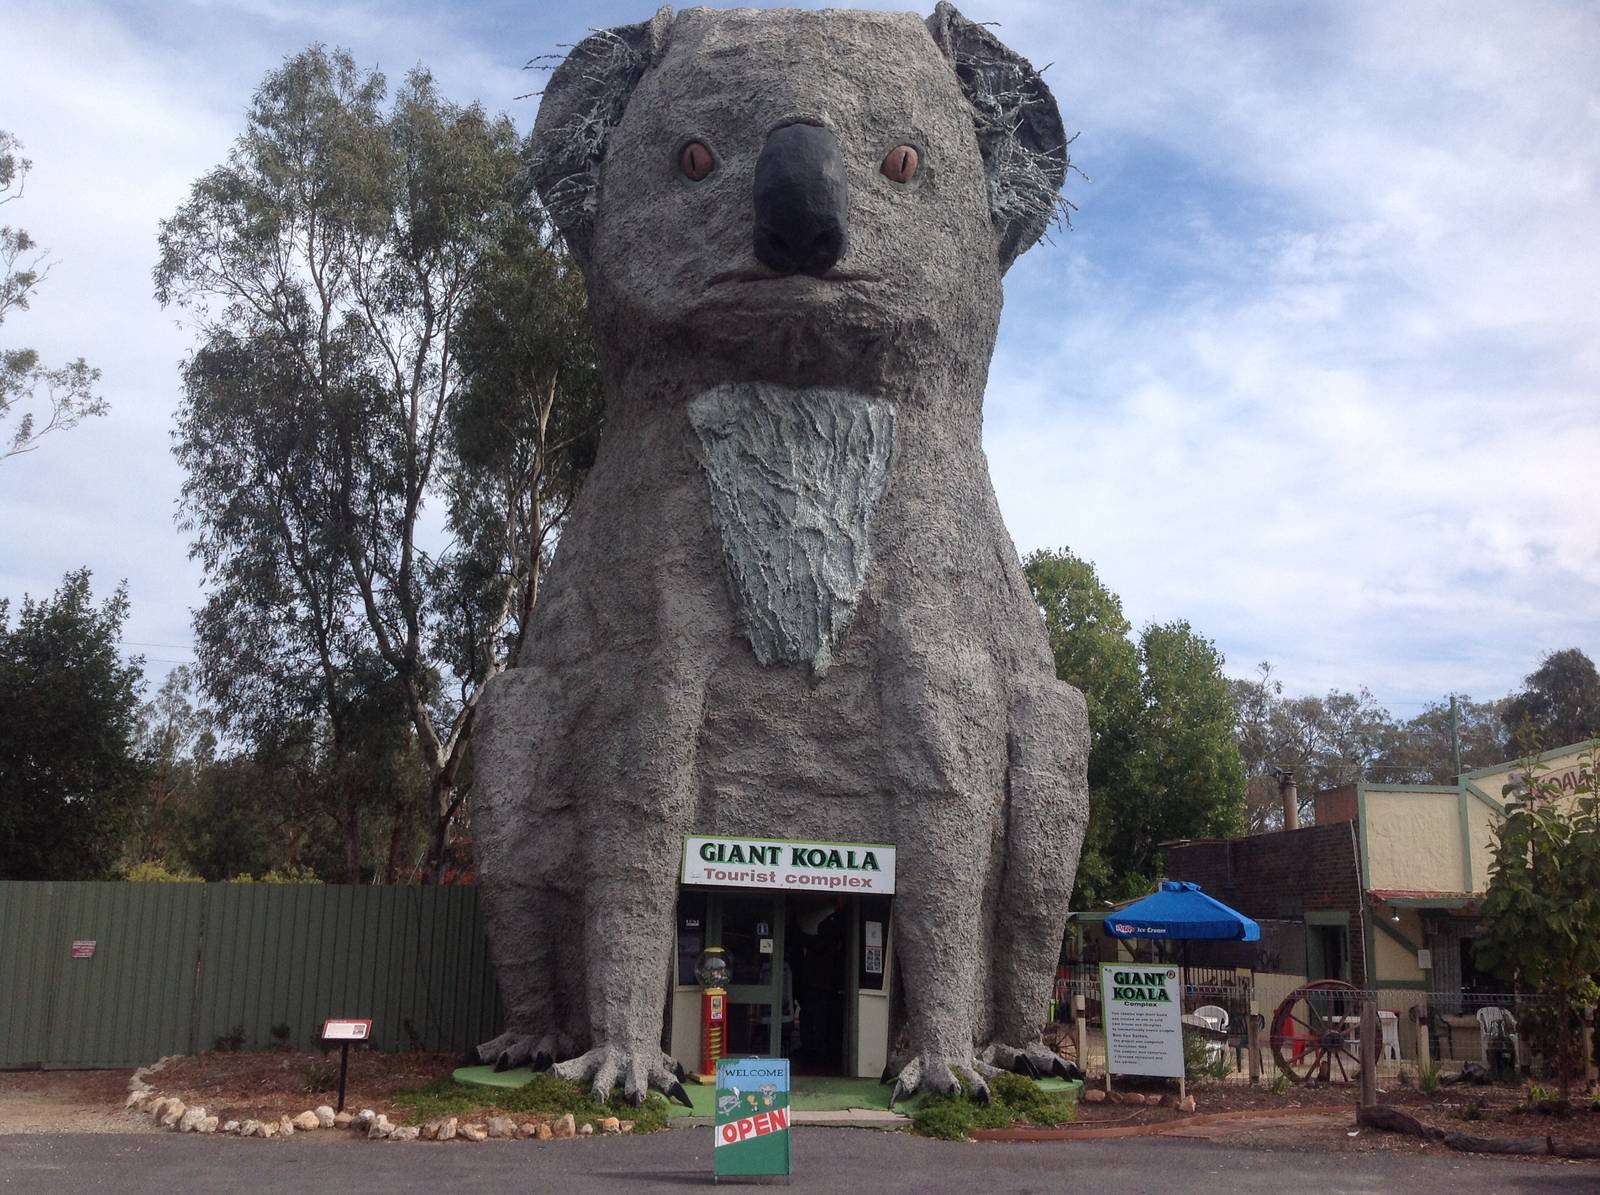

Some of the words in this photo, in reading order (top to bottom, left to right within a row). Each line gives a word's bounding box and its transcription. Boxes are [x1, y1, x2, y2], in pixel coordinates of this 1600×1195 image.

[700, 842, 783, 866] GIANT
[791, 847, 881, 872] KOALA
[704, 868, 776, 883] Tourist
[785, 873, 872, 888] complex
[1114, 972, 1167, 986] GIANT
[1112, 986, 1171, 1002] KOALA
[725, 1069, 784, 1077] WELCOME
[722, 1108, 787, 1143] OPEN
